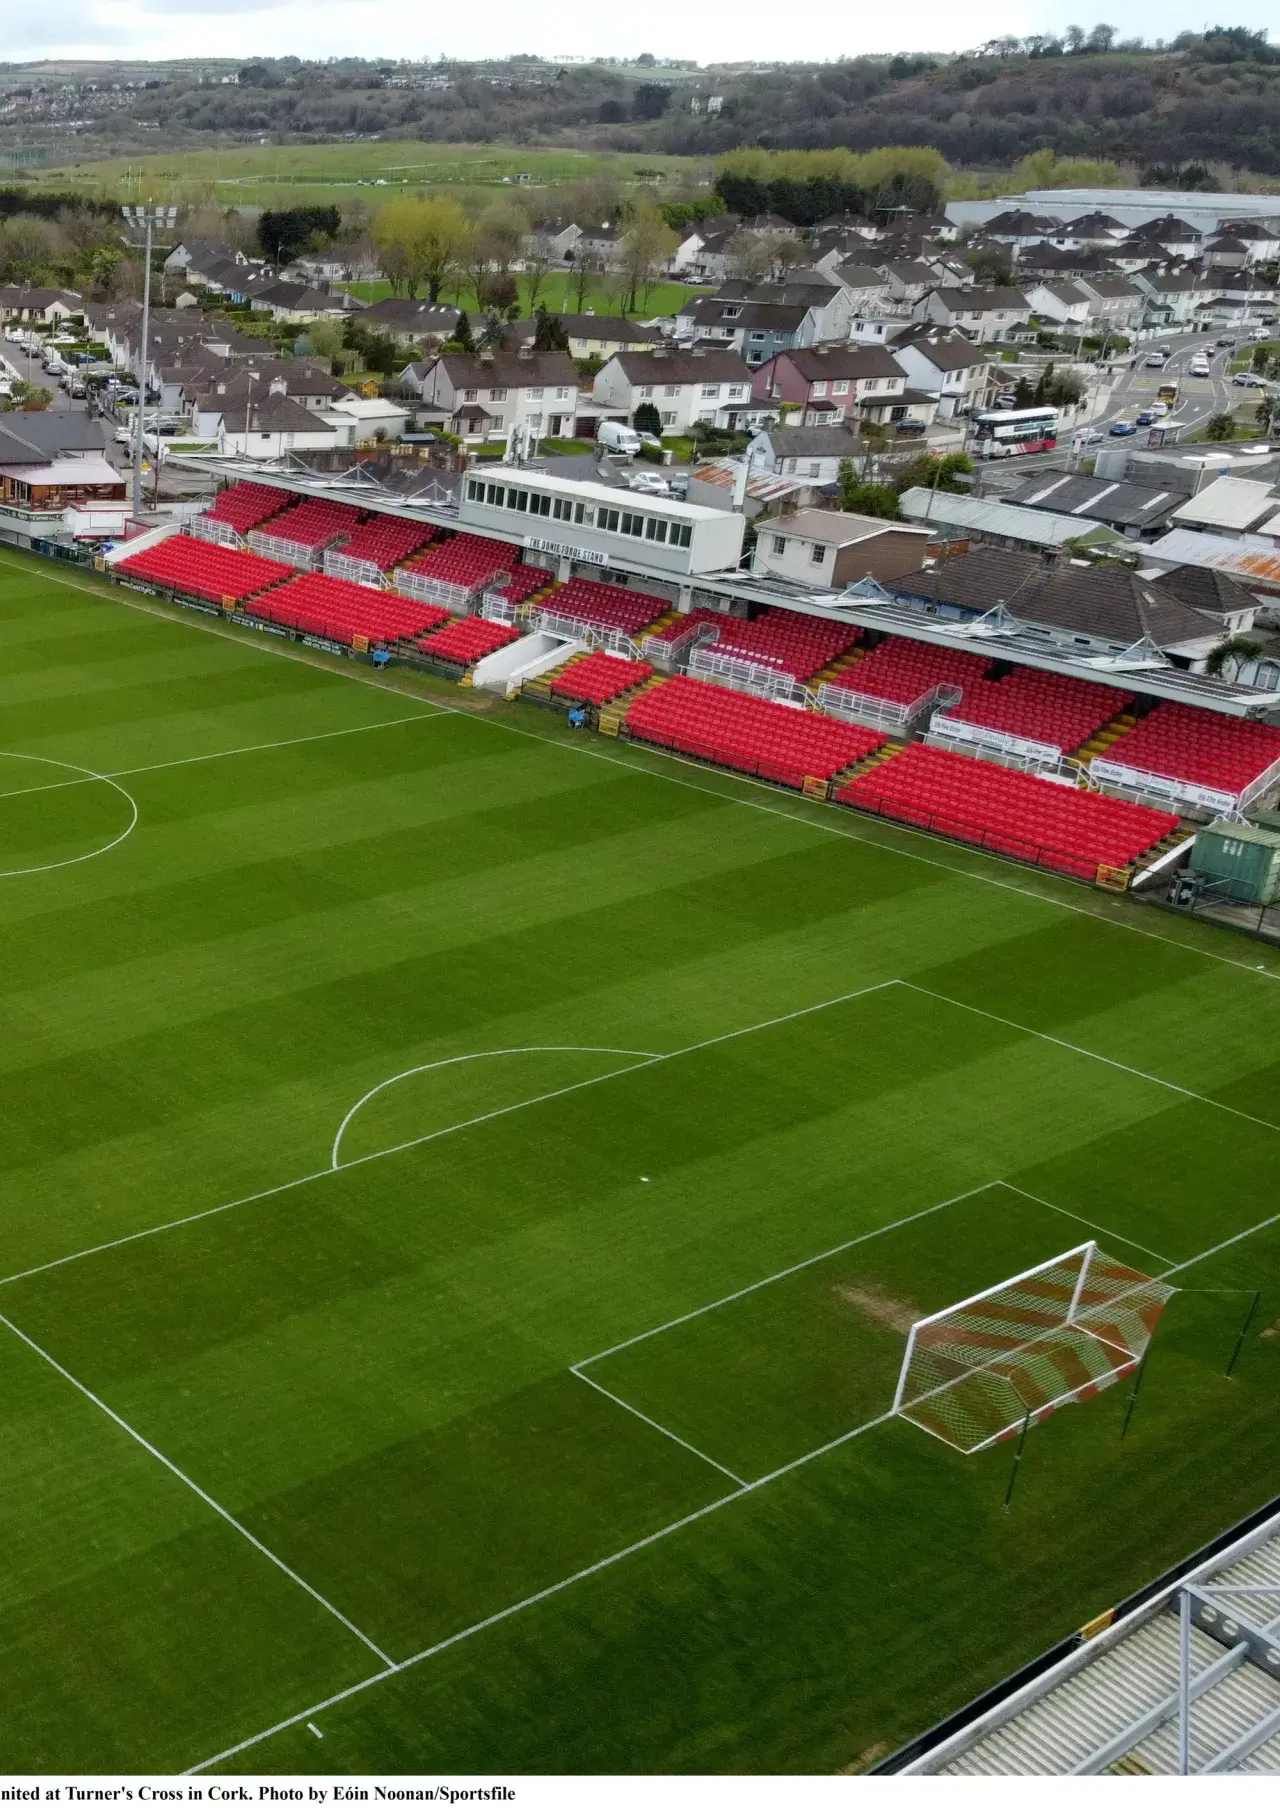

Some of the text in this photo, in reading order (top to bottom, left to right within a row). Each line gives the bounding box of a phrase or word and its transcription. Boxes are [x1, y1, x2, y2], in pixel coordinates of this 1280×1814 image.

[529, 537, 604, 563] THE DONIE FORDE STAND
